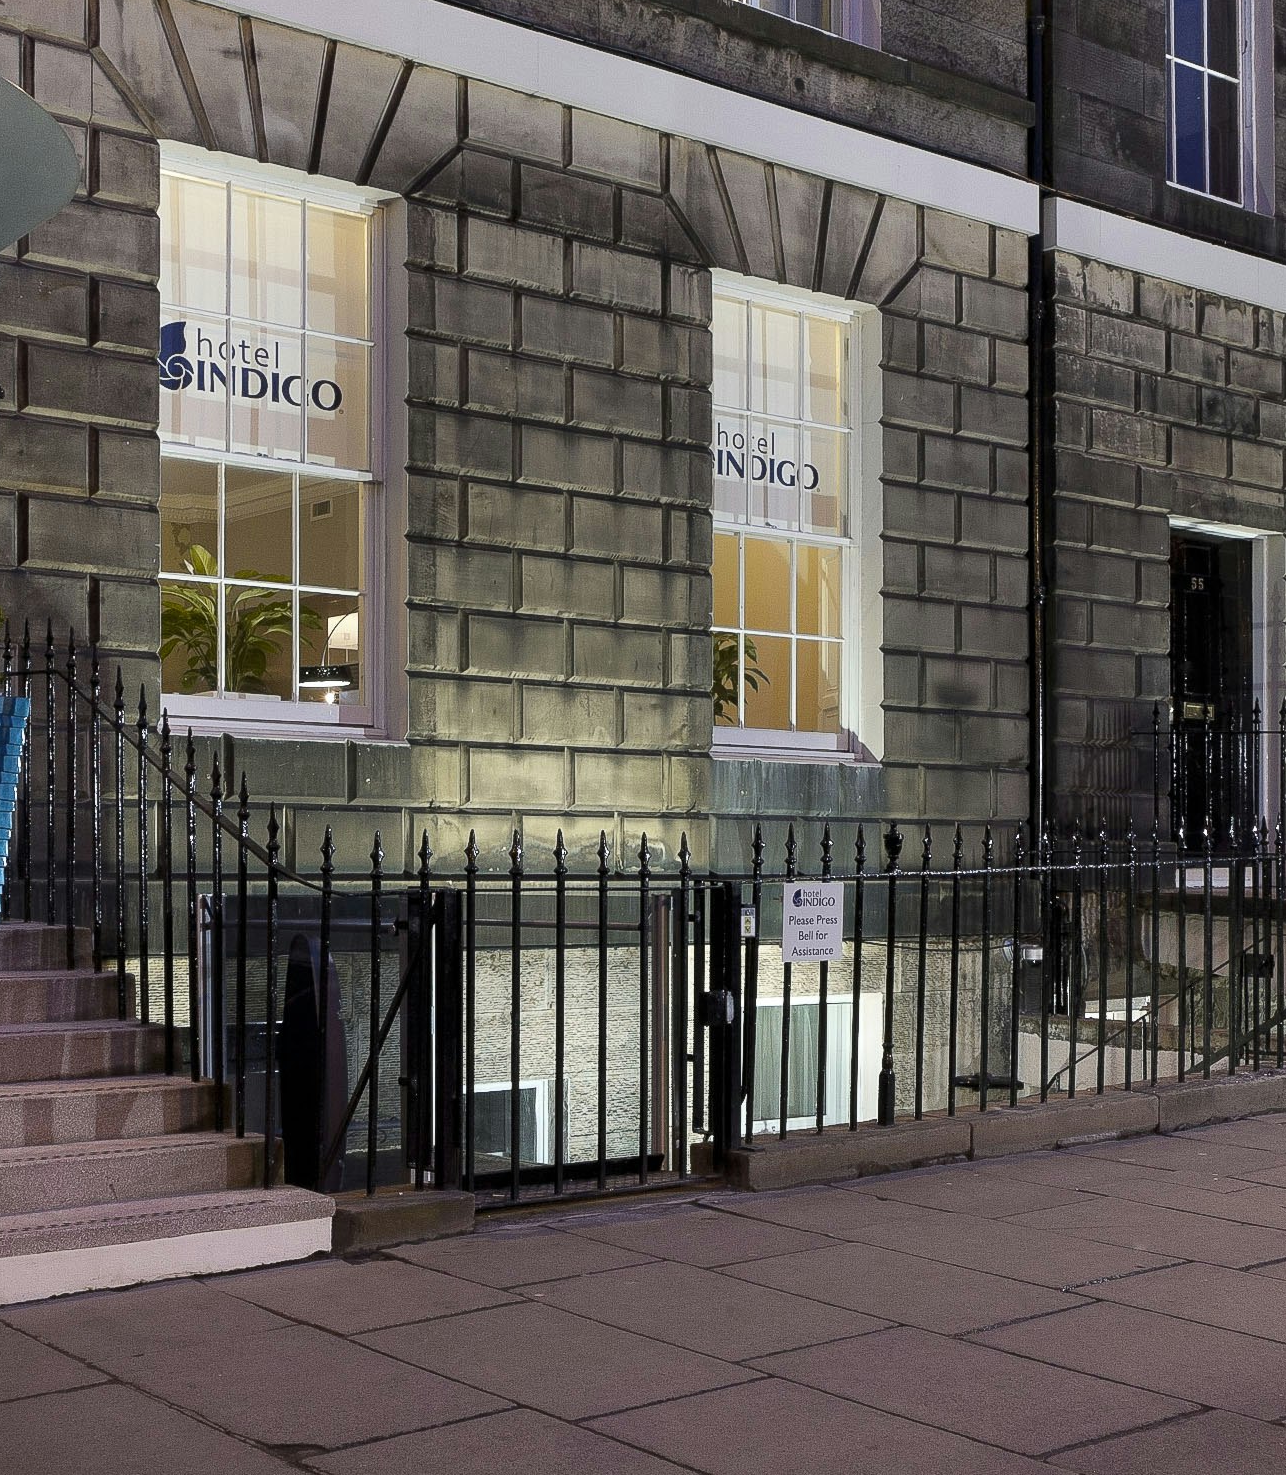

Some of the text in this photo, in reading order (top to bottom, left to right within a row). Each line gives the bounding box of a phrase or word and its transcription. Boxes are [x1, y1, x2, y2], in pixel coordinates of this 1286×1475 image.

[197, 328, 279, 369] hotel
[197, 359, 343, 412] INDIGO
[717, 422, 775, 456] hoel
[803, 889, 822, 897] hotel
[803, 897, 835, 907] INDIGO
[789, 915, 838, 925] Please Press
[799, 930, 828, 940] Bell for
[791, 946, 834, 956] Assistance
